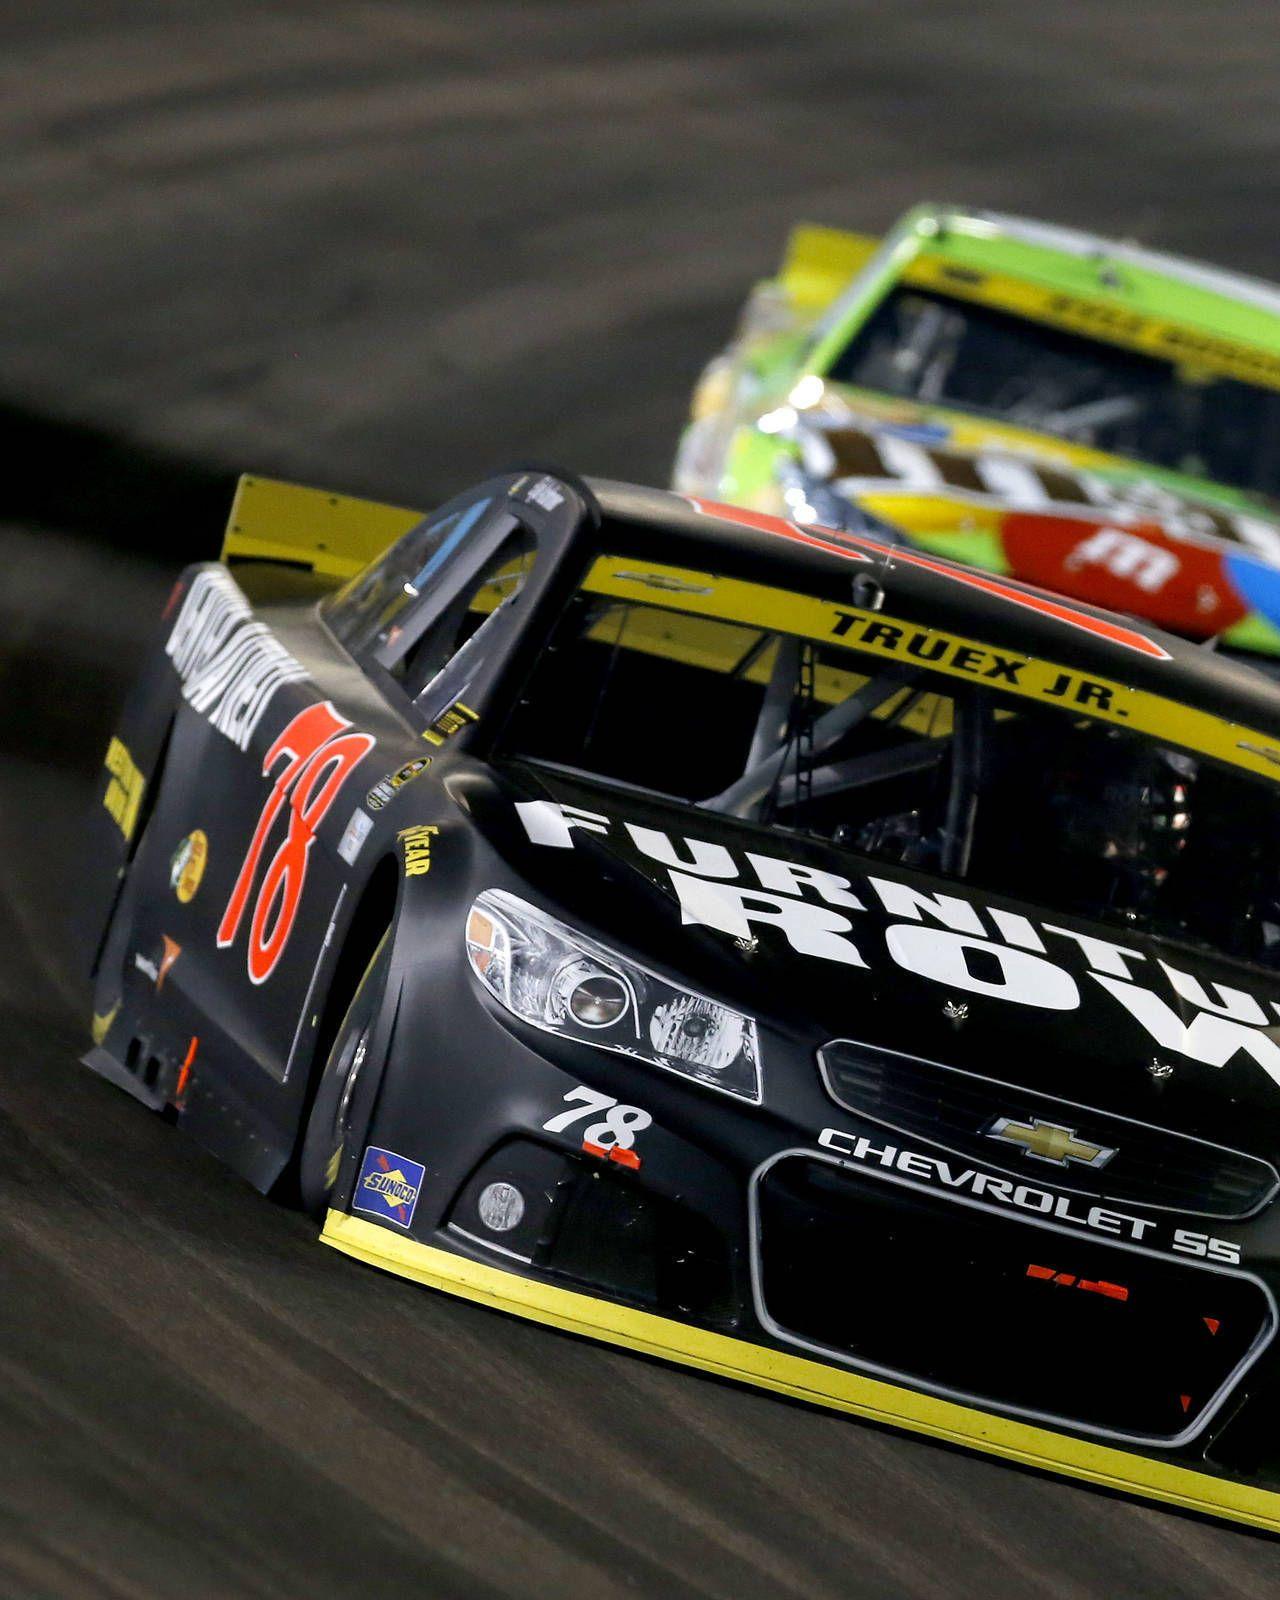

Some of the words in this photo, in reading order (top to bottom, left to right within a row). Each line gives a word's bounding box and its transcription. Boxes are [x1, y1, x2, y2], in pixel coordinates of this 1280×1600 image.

[831, 610, 1023, 684] TRUEX
[1042, 675, 1130, 717] JR.
[217, 701, 376, 985] 78
[543, 1085, 652, 1151] 78
[365, 1173, 416, 1204] SUNOCO
[818, 1128, 1157, 1240] CHEVROLET
[1173, 1229, 1240, 1265] SS
